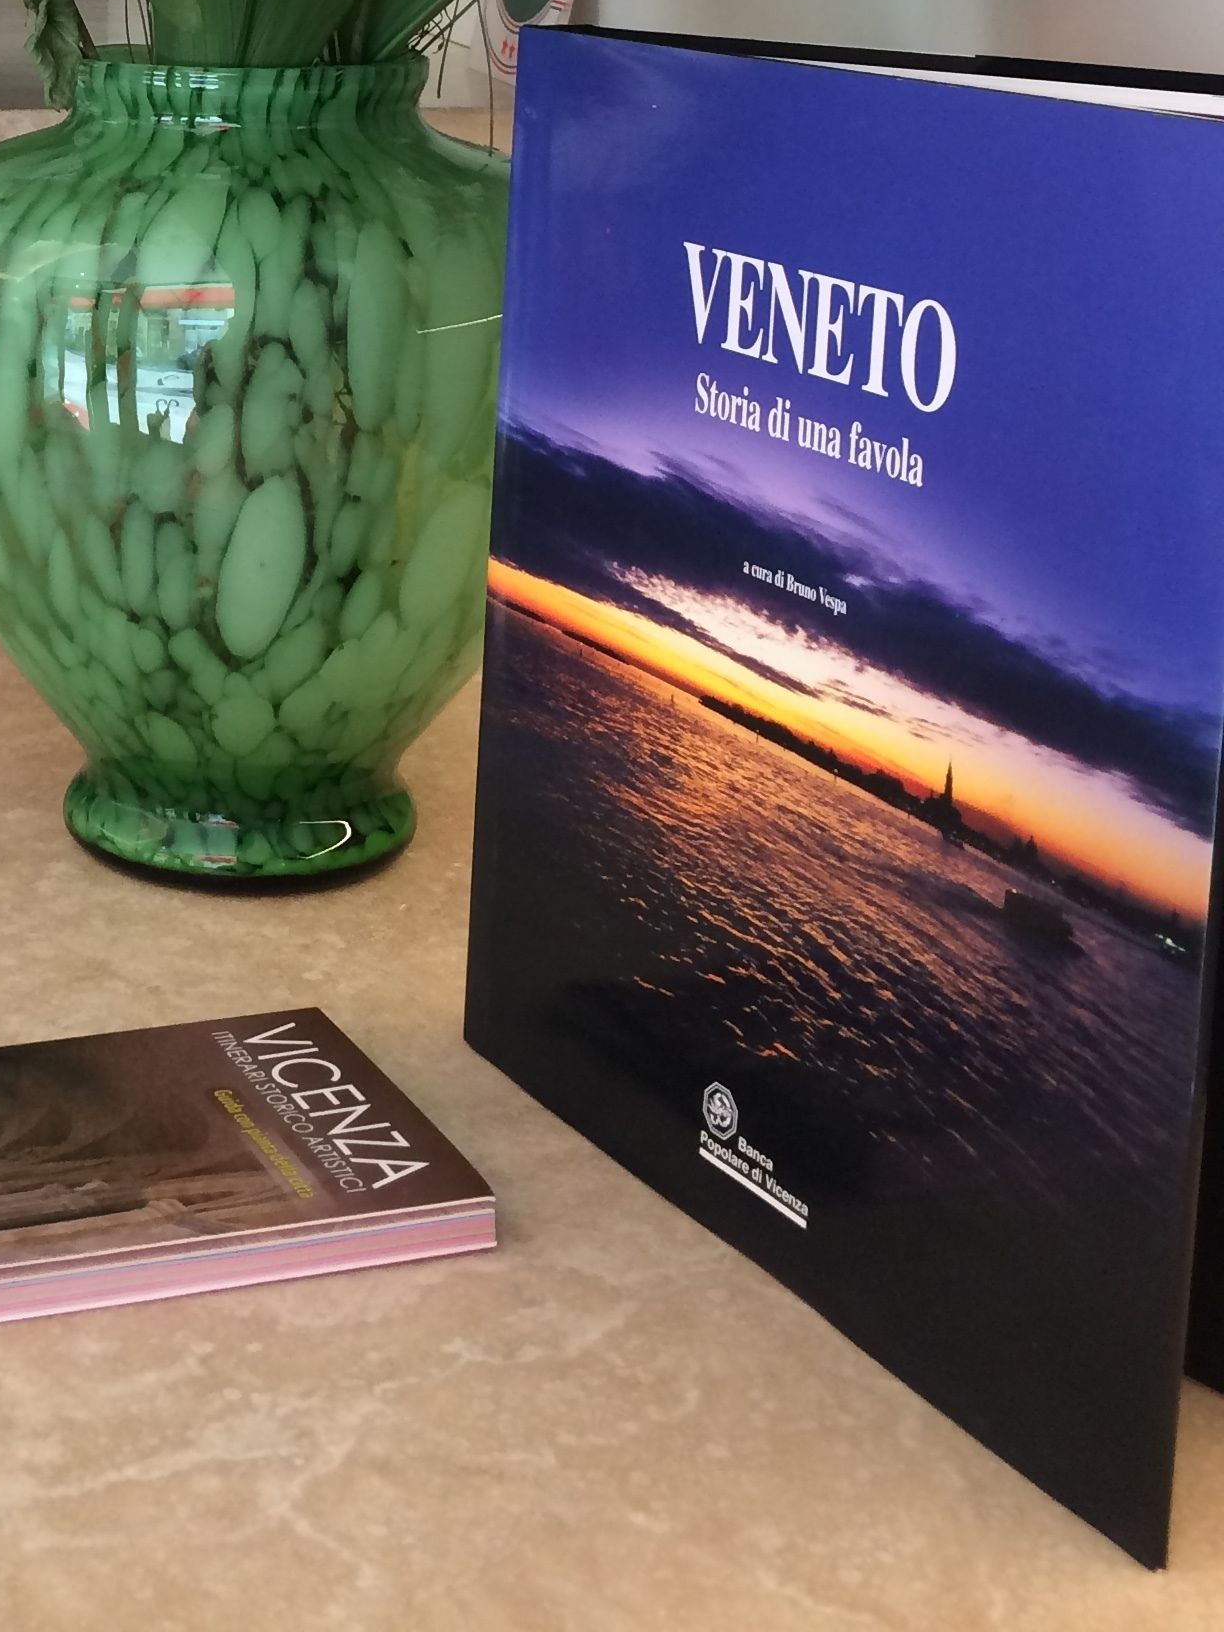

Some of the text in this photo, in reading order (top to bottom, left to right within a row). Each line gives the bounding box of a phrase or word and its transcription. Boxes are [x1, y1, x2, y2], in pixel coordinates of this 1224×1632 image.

[683, 241, 957, 412] VENETO
[694, 372, 924, 487] Storia di una favola
[743, 561, 847, 616] a cura di Bruno Vespa
[211, 1031, 367, 1193] ITINERARI STORICO ARTISTICI
[243, 1022, 430, 1189] VICENZA
[738, 1136, 773, 1171] Banca
[700, 1130, 809, 1217] Popolare di Vicenza
